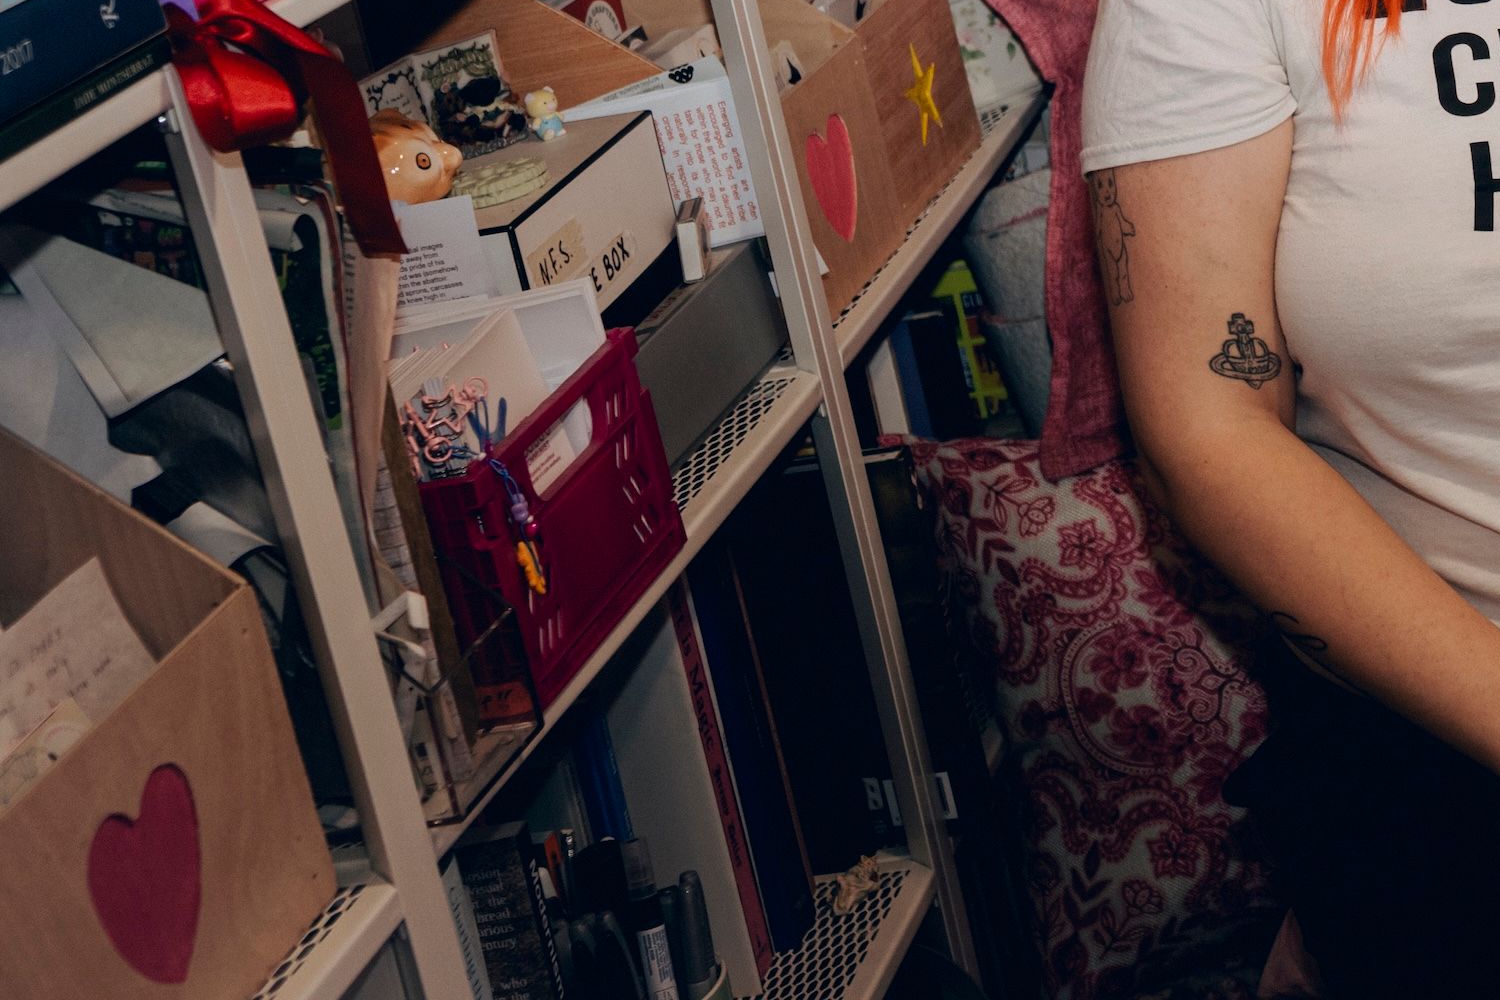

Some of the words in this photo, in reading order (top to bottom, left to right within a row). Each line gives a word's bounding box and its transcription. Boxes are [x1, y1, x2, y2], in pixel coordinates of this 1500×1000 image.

[1, 38, 35, 76] 2017
[673, 114, 688, 145] naturally
[685, 152, 694, 166] into
[707, 104, 724, 149] encouraged
[721, 152, 728, 160] to
[731, 184, 741, 200] their
[718, 101, 733, 138] Emerging
[731, 148, 743, 170] artists
[741, 179, 749, 192] are
[748, 201, 758, 220] often
[676, 165, 692, 199] response
[685, 110, 694, 125] task
[695, 143, 705, 164] those
[702, 168, 711, 184] who
[714, 207, 722, 218] not
[696, 107, 707, 129] within
[703, 131, 711, 143] the
[707, 146, 715, 156] art
[711, 158, 722, 178] world
[721, 194, 736, 226] daunting
[420, 243, 444, 251] images
[538, 240, 574, 286] N.F.S.
[602, 236, 630, 281] BOX
[422, 265, 459, 277] (somehow)
[430, 281, 464, 292] carcasses
[423, 294, 438, 302] high
[685, 665, 715, 750] Magic
[529, 857, 566, 1000] Modernism
[500, 977, 528, 991] who
